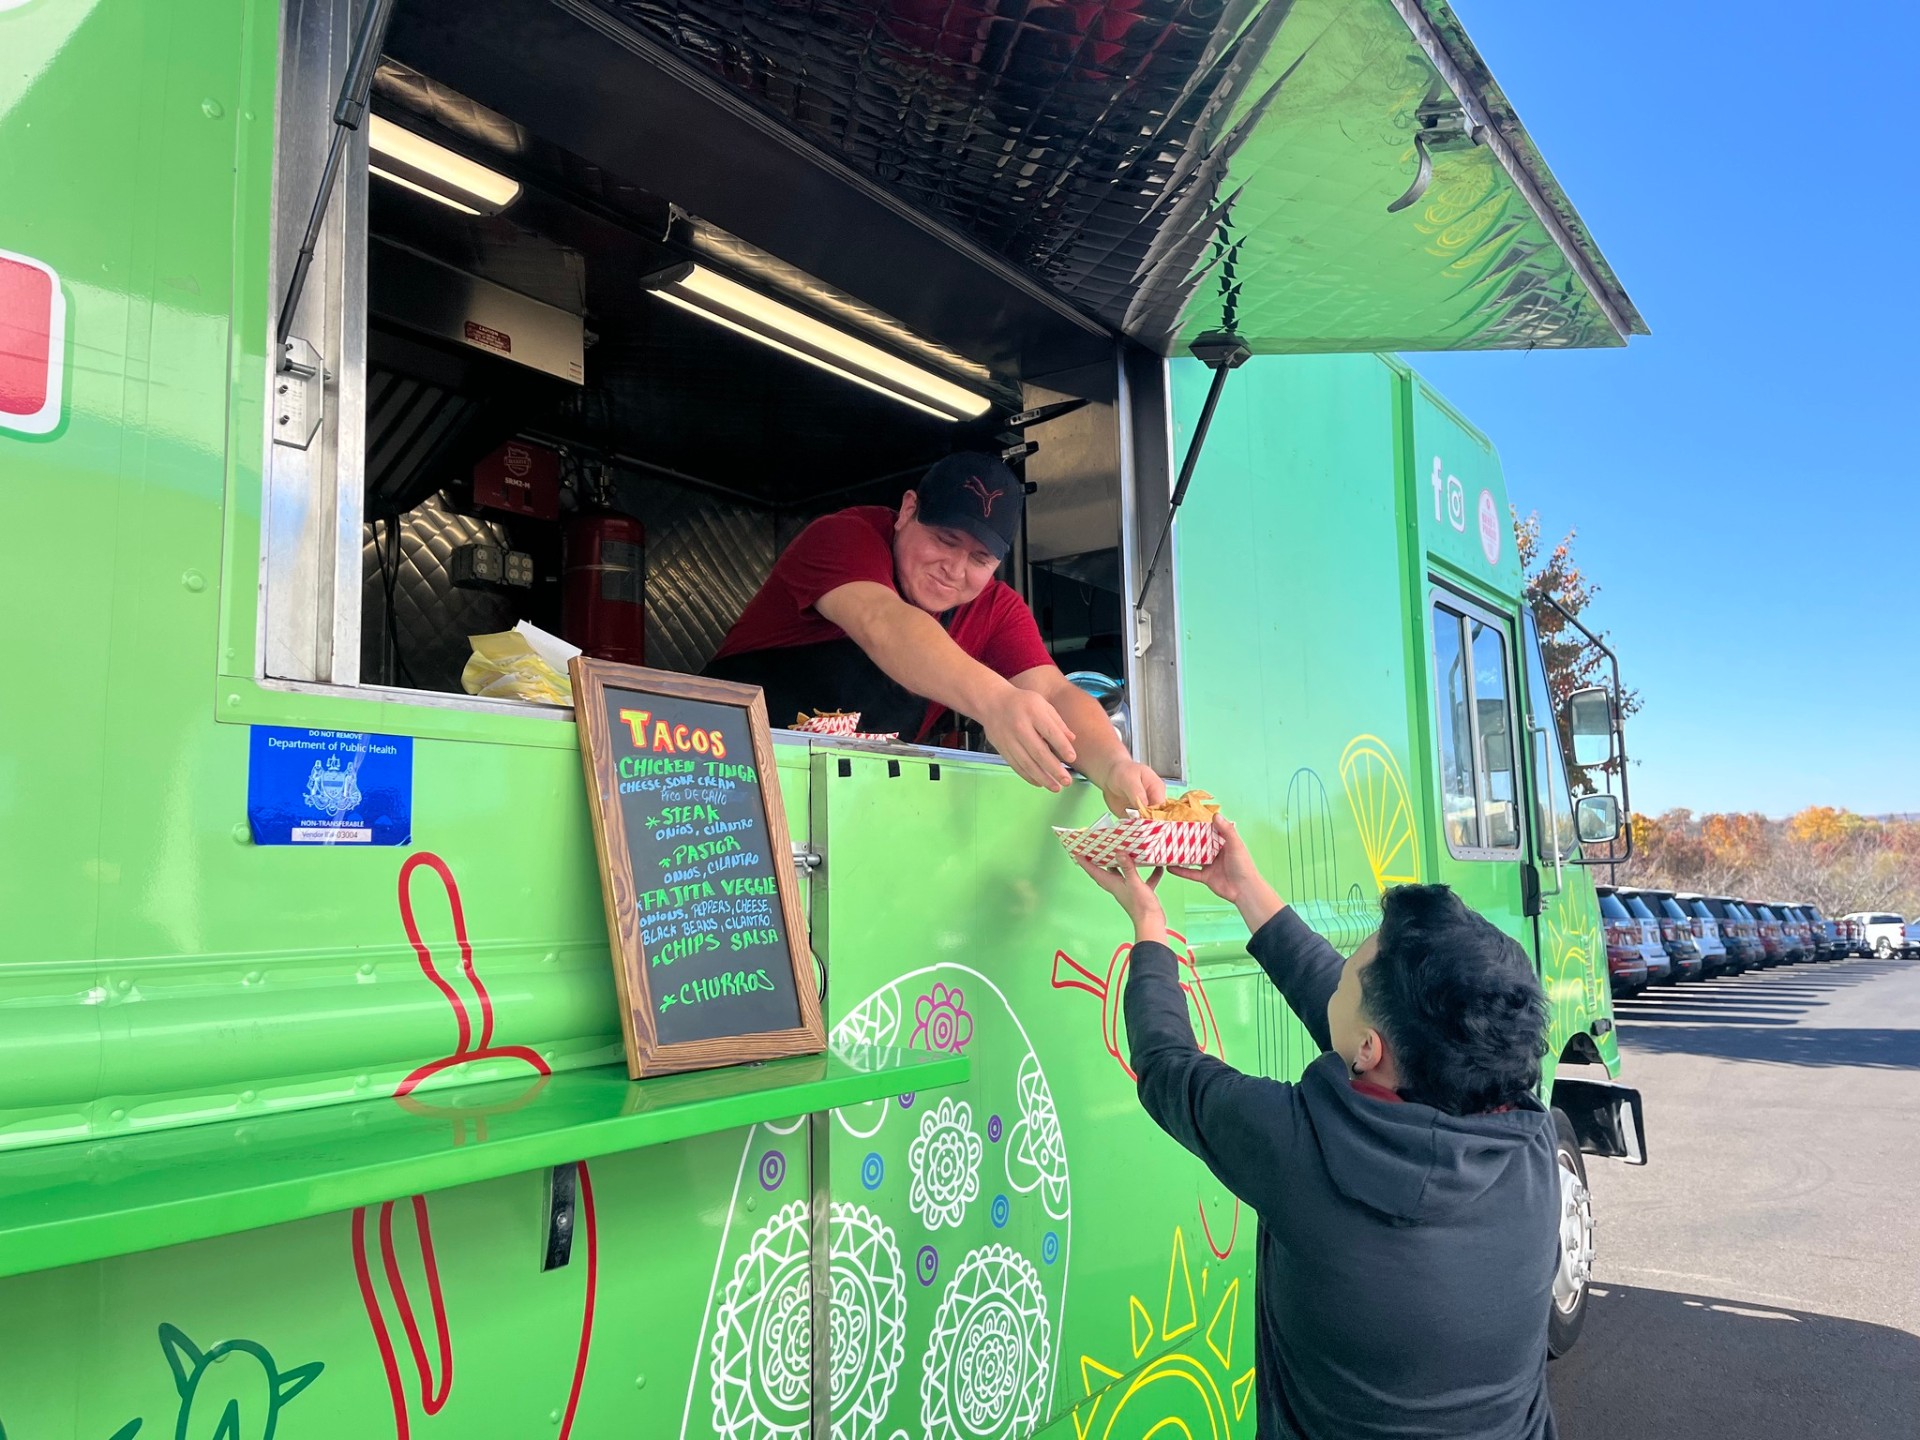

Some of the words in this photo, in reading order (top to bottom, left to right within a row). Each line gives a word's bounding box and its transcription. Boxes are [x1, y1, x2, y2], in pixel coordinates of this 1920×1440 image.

[320, 731, 335, 739] NOT
[336, 732, 363, 740] REMOVE
[619, 708, 727, 759] TACOS
[268, 737, 326, 750] Department
[328, 741, 338, 751] of
[340, 742, 367, 753] Public
[369, 744, 397, 755] Health
[619, 756, 696, 779] CHICKEN
[703, 761, 758, 784] TINGA
[698, 776, 735, 790] CREAM
[684, 787, 700, 802] DE
[300, 820, 365, 828] NON-TRANSFERABLE
[661, 804, 721, 825] STEAK
[302, 831, 324, 839] Vendor
[336, 831, 358, 839] 03004
[703, 818, 754, 836] CILANTRO
[672, 835, 742, 866] PASTOR
[707, 852, 760, 875] CILANTRO
[640, 881, 716, 911] FAJITA
[720, 876, 778, 897] VEGGIE
[640, 924, 677, 946] BLACK
[661, 932, 721, 966] CHIPS
[730, 928, 779, 952] SALSA
[679, 969, 775, 1005] CHURROS
